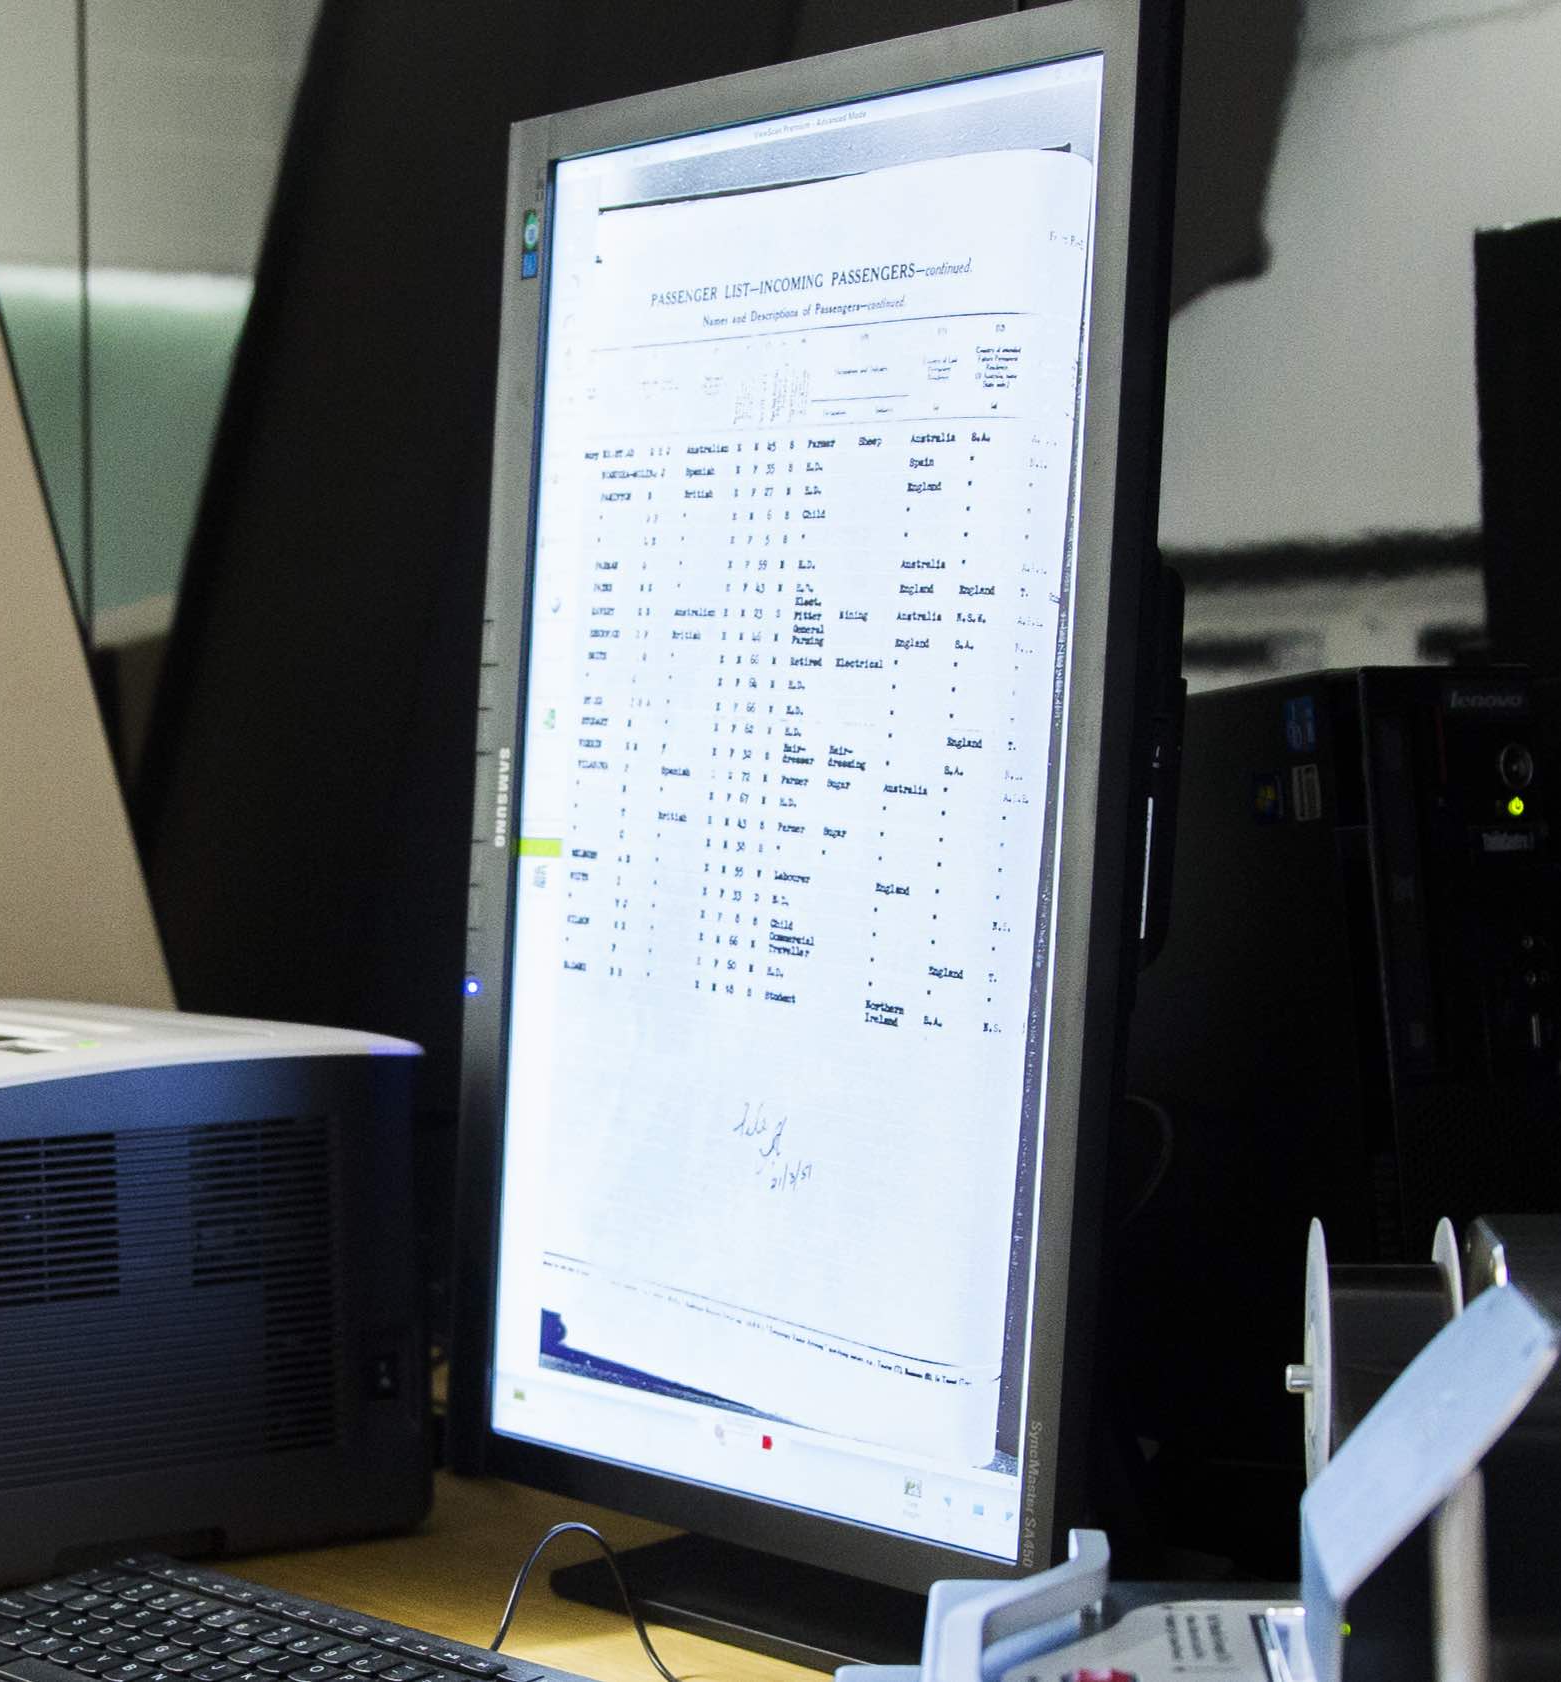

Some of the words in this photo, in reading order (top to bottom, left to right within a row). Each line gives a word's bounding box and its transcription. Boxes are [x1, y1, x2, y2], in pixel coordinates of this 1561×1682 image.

[650, 287, 718, 306] PASSENGER
[702, 315, 729, 328] Names
[750, 307, 799, 323] Descriptions
[802, 304, 813, 317] of
[911, 432, 956, 443] Australia
[909, 457, 934, 469] Spain
[907, 481, 942, 494] England
[802, 509, 826, 520] Child
[900, 559, 946, 569] Australia
[899, 584, 934, 596] England
[959, 585, 995, 596] England
[839, 610, 868, 622] Mining
[896, 611, 942, 622] Australia
[793, 624, 825, 636] General
[895, 638, 929, 650] England
[790, 657, 822, 667] Retired
[835, 658, 883, 669] Electrical
[1449, 690, 1524, 710] lenovo
[946, 737, 982, 749] England
[883, 784, 927, 796] Australia
[494, 747, 511, 848] SAMSUNG
[774, 870, 810, 884] Labourer
[875, 882, 910, 896] England
[770, 919, 793, 931] Child
[769, 930, 815, 948] Commercial
[769, 942, 811, 957] Traveller
[928, 966, 963, 979] England
[765, 991, 795, 1004] Student
[865, 1000, 904, 1016] Northern
[865, 1012, 900, 1027] Ireland
[1024, 1420, 1043, 1513] SyncMaster
[1022, 1517, 1037, 1568] SA450
